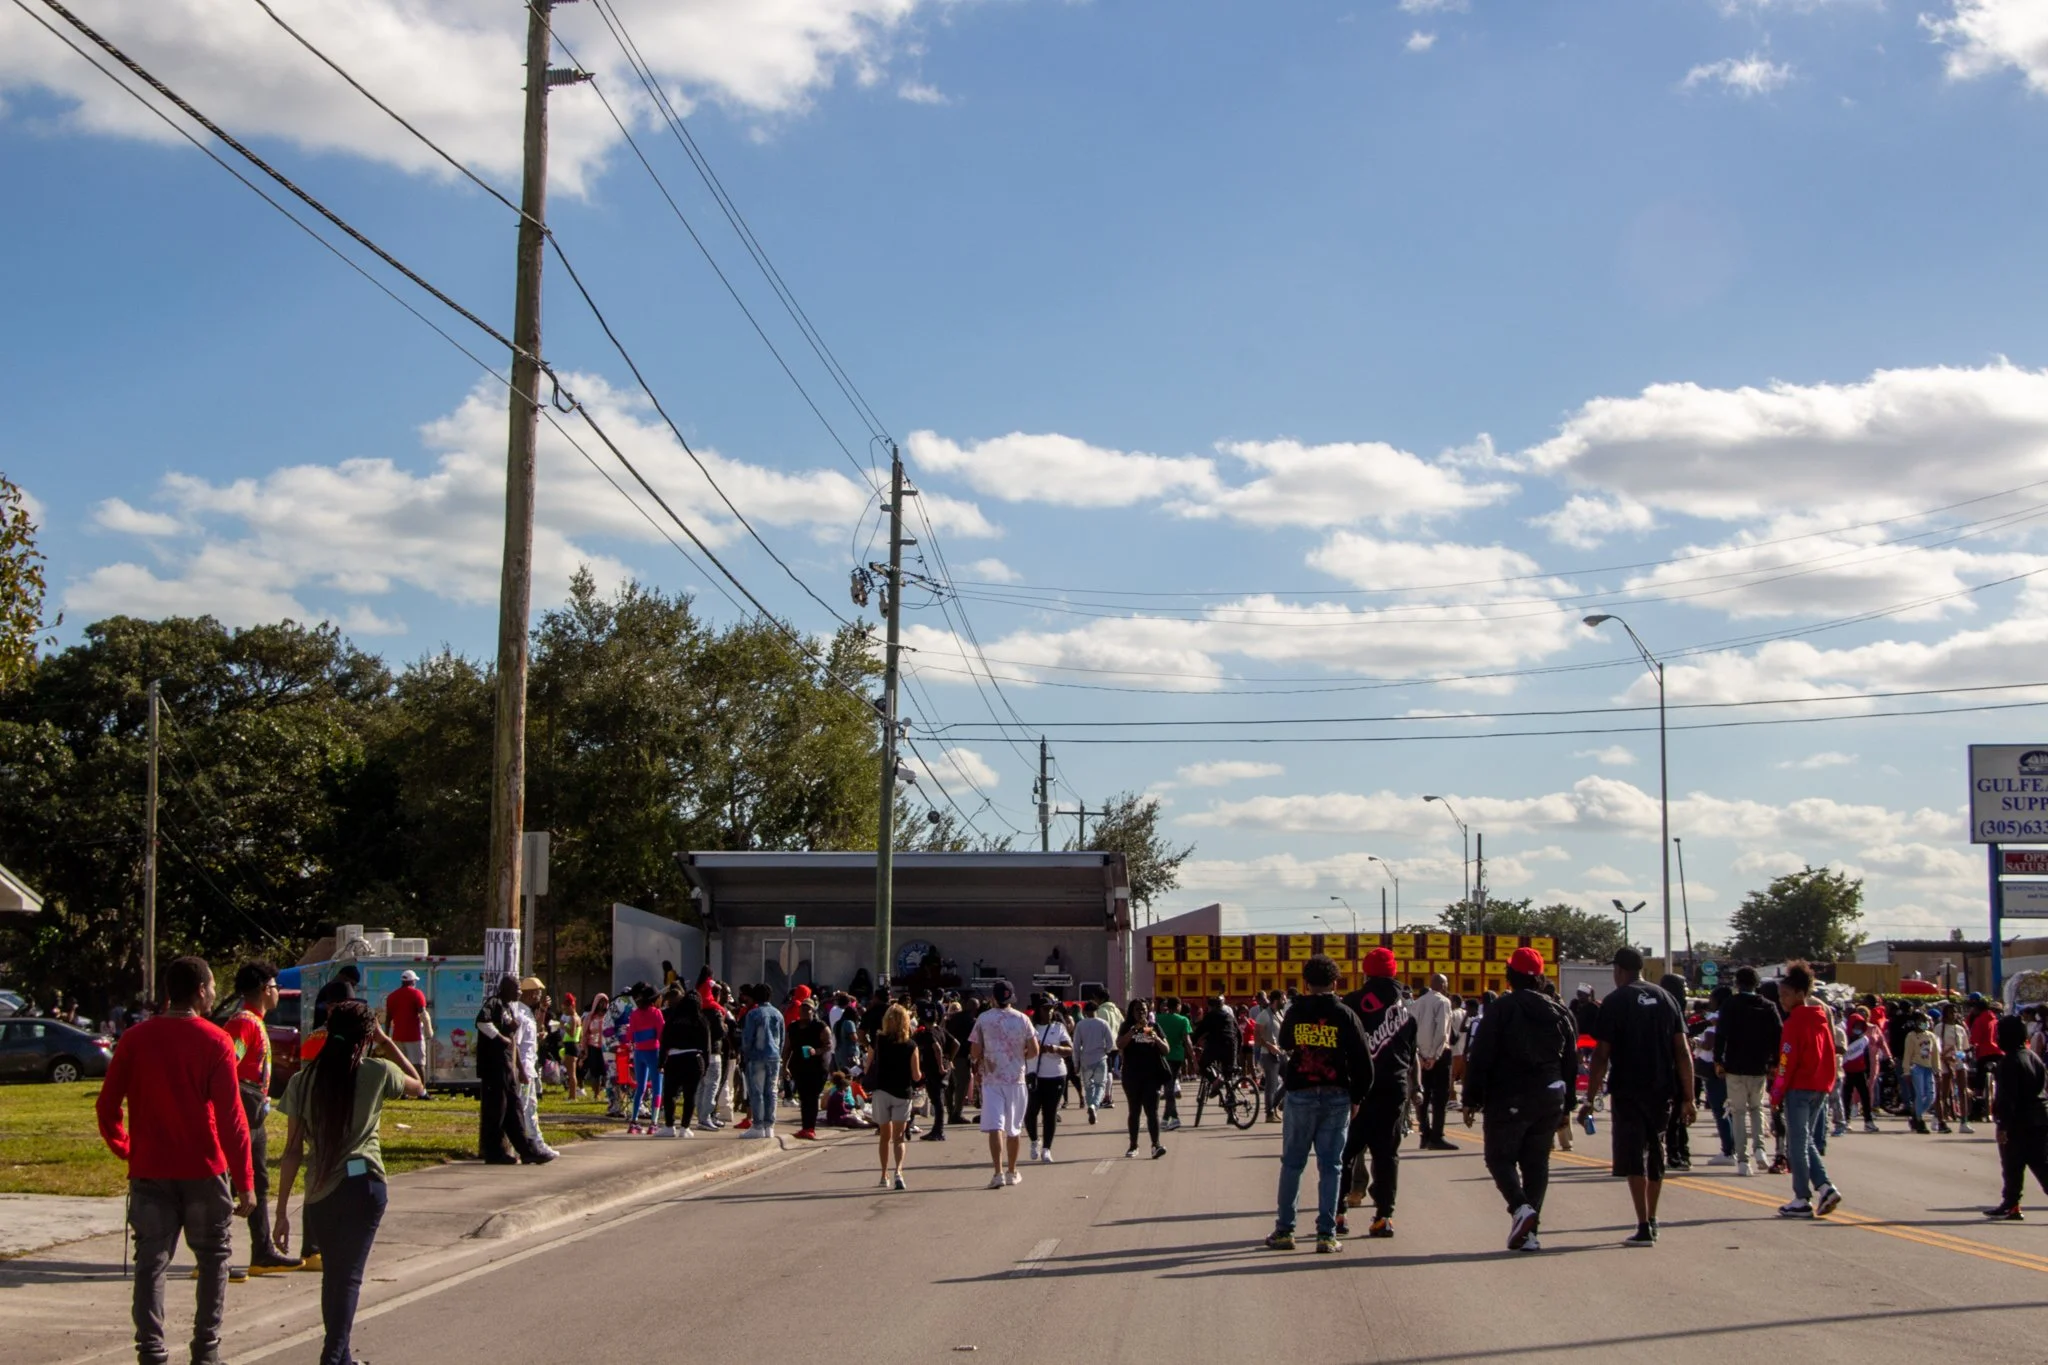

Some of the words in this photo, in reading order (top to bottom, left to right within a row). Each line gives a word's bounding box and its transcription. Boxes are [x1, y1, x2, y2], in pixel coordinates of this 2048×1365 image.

[2006, 862, 2048, 872] SATUR
[1294, 1023, 1338, 1037] HEART
[1295, 1034, 1337, 1048] BREAK
